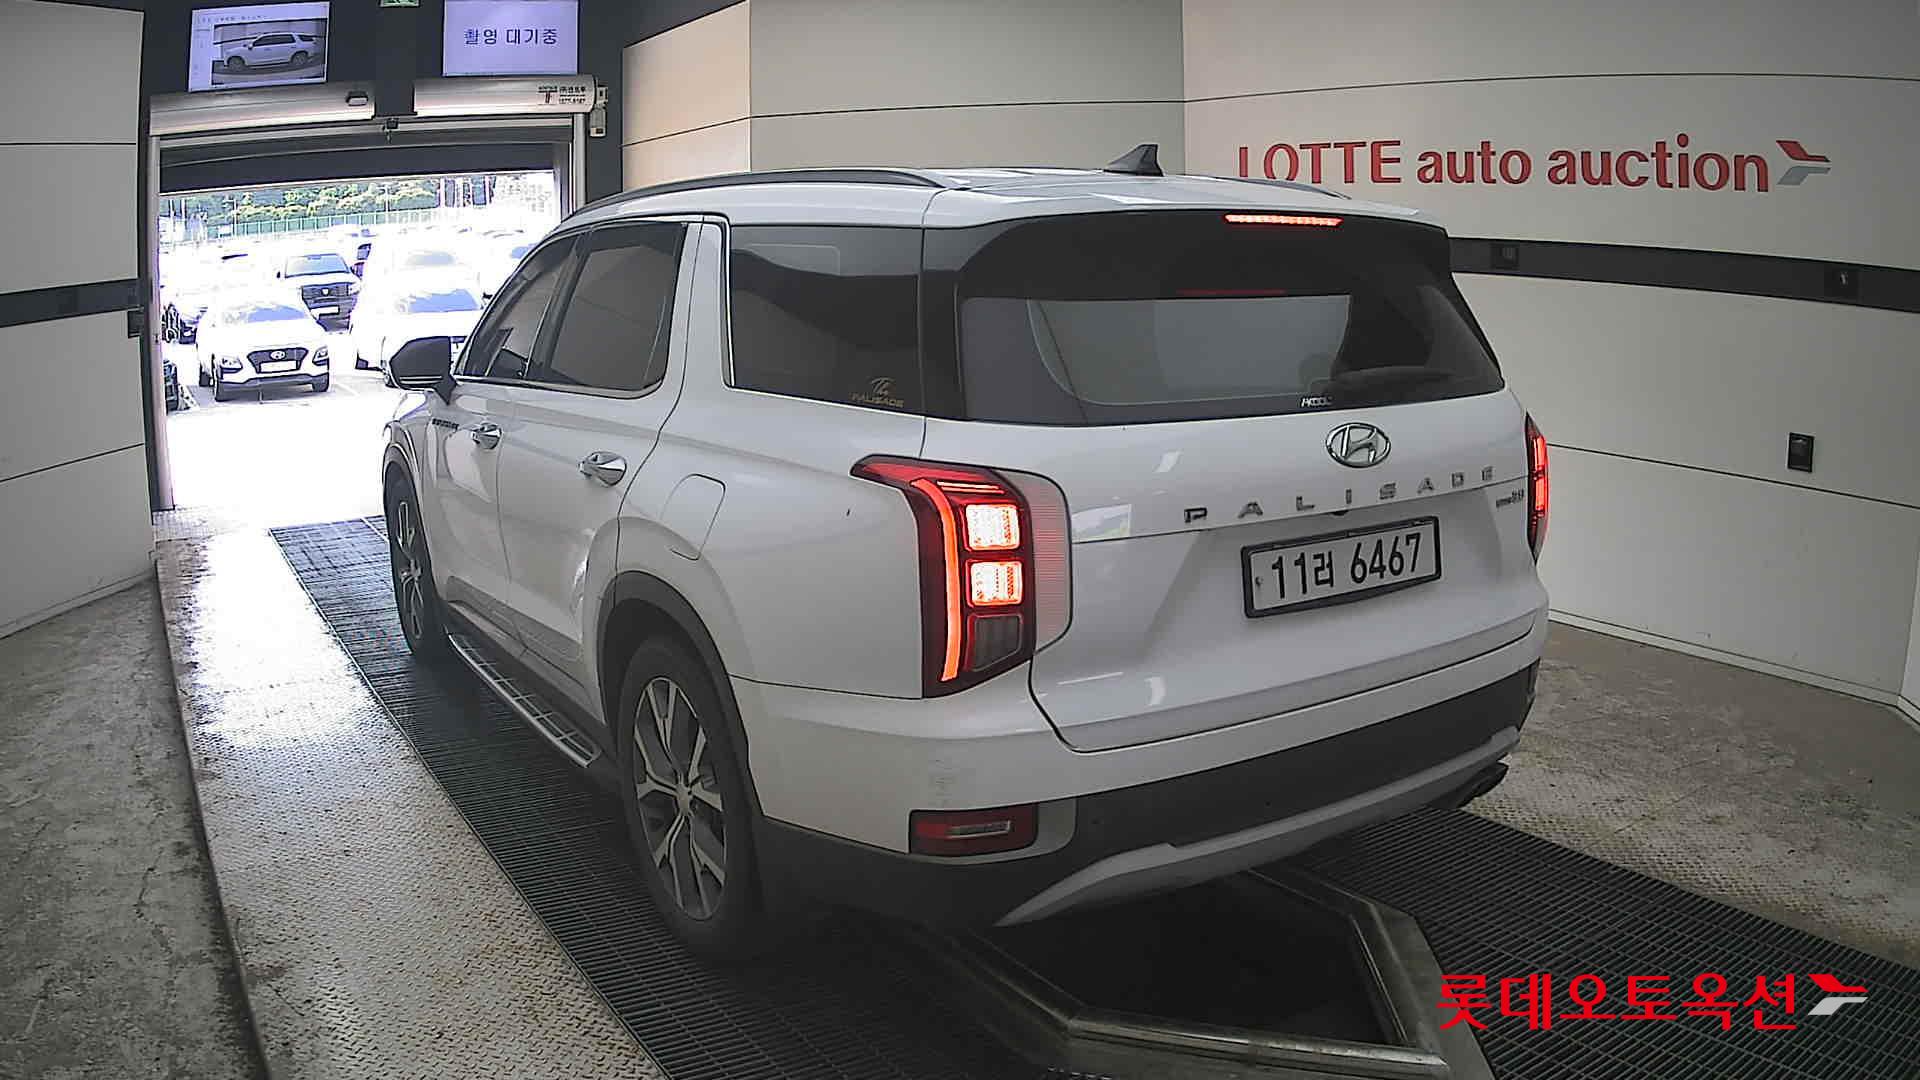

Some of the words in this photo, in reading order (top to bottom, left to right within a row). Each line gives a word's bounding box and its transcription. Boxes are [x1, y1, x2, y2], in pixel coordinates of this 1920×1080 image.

[506, 28, 557, 45] 대기중
[1416, 140, 1532, 185] auto
[1547, 134, 1769, 192] auction
[1184, 465, 1494, 523] PALISADE
[1271, 550, 1334, 599] 11러
[1350, 532, 1421, 584] 6467
